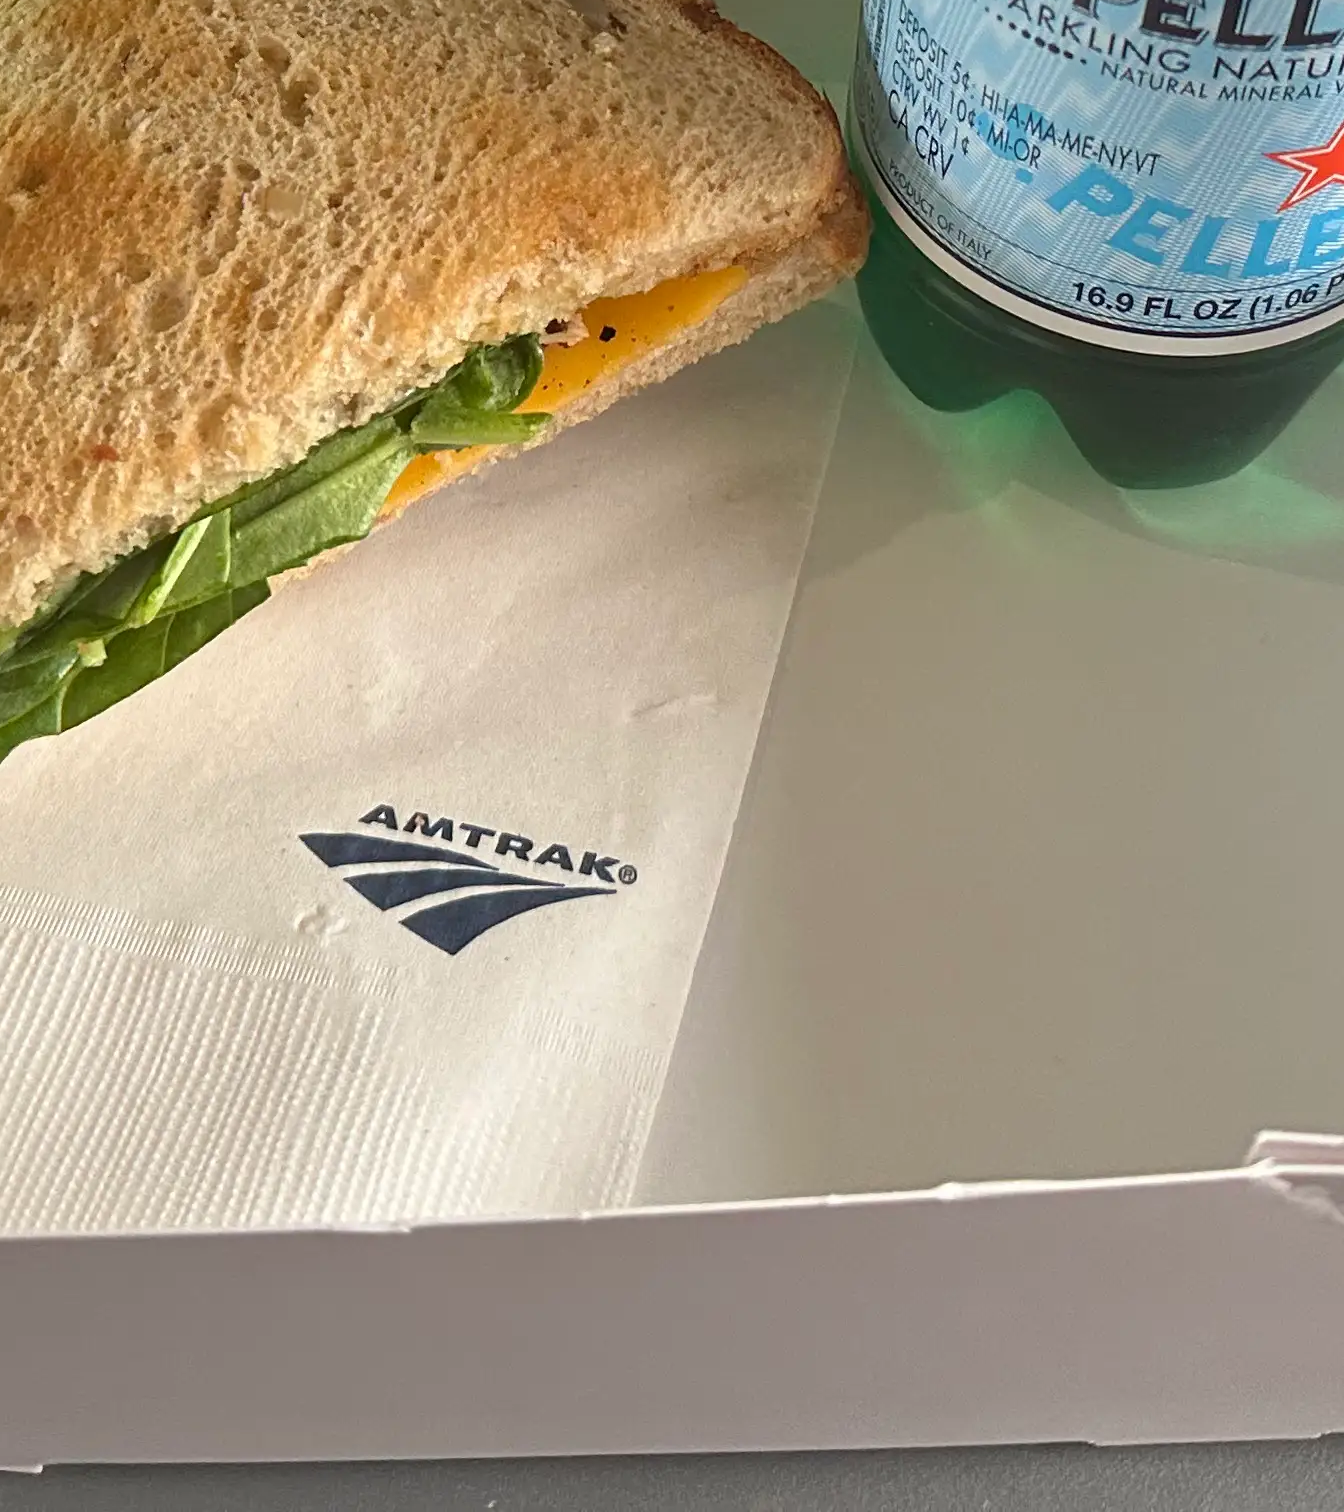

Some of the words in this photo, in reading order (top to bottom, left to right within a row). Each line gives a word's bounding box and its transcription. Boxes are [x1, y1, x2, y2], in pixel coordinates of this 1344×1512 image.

[895, 28, 944, 102] DEPOSIT
[899, 0, 949, 73] DEPOSIT
[1099, 59, 1208, 99] NATURAL
[1217, 82, 1324, 103] MINERAL
[888, 89, 910, 143] CA
[915, 125, 955, 180] CRV
[888, 159, 935, 218] PRODUCT
[937, 213, 955, 235] OF
[957, 229, 992, 261] ITALY
[1072, 282, 1134, 314] 16.9
[1143, 296, 1182, 321] FL
[1192, 299, 1244, 322] OZ
[1248, 282, 1319, 322] (1.06
